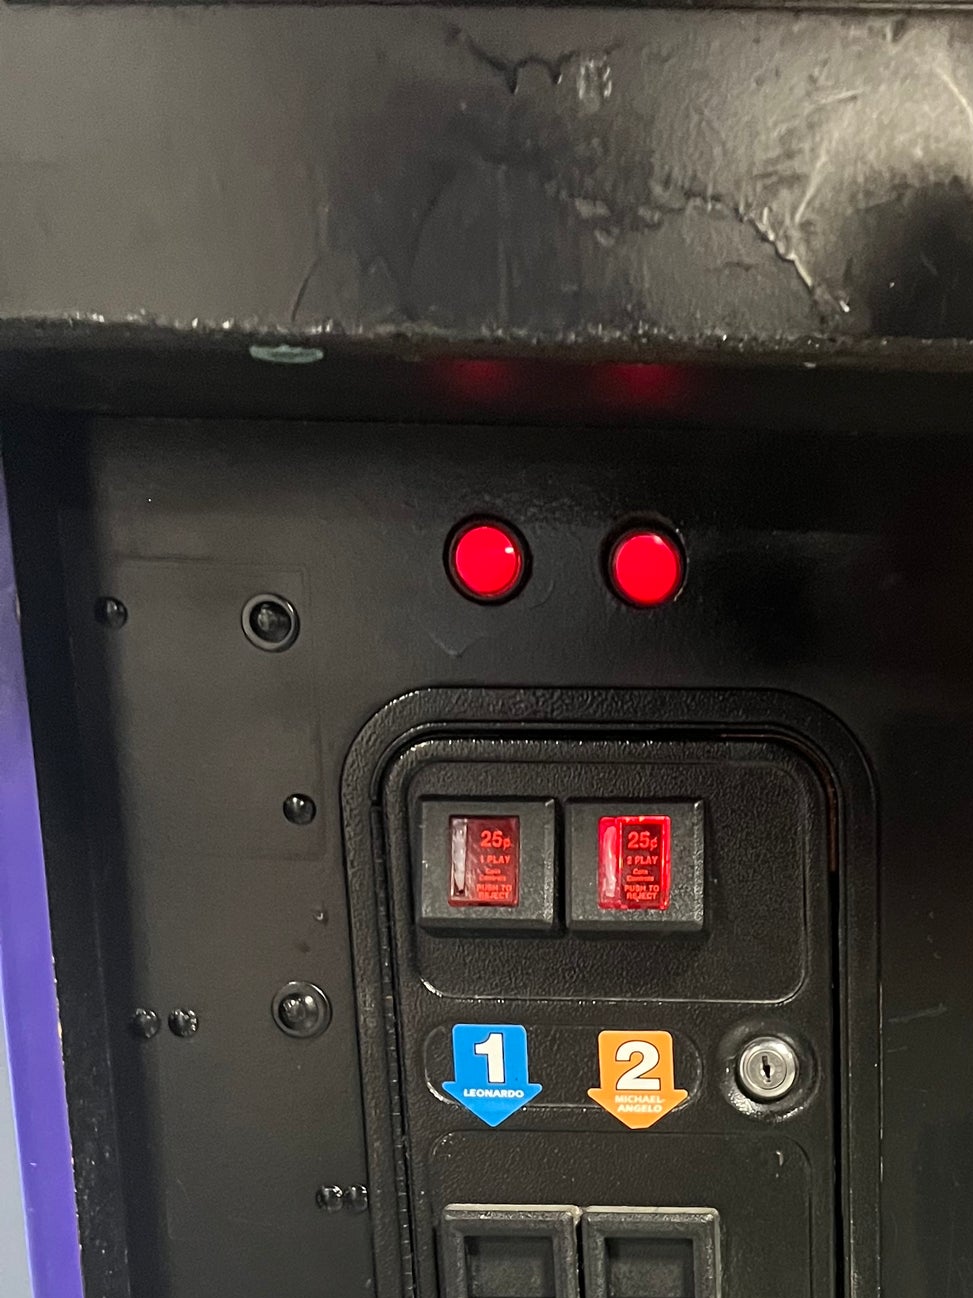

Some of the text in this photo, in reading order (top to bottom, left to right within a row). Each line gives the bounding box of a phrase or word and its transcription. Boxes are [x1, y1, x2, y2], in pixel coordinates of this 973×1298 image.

[627, 831, 658, 851] 25¢
[487, 855, 511, 864] PLAY
[634, 855, 659, 865] PLAY
[501, 883, 513, 892] TO
[624, 884, 660, 892] PUSH TO
[474, 1032, 505, 1083] 1
[615, 1040, 661, 1091] 2
[463, 1088, 525, 1099] LEONARDO
[617, 1104, 663, 1113] ANGELO
